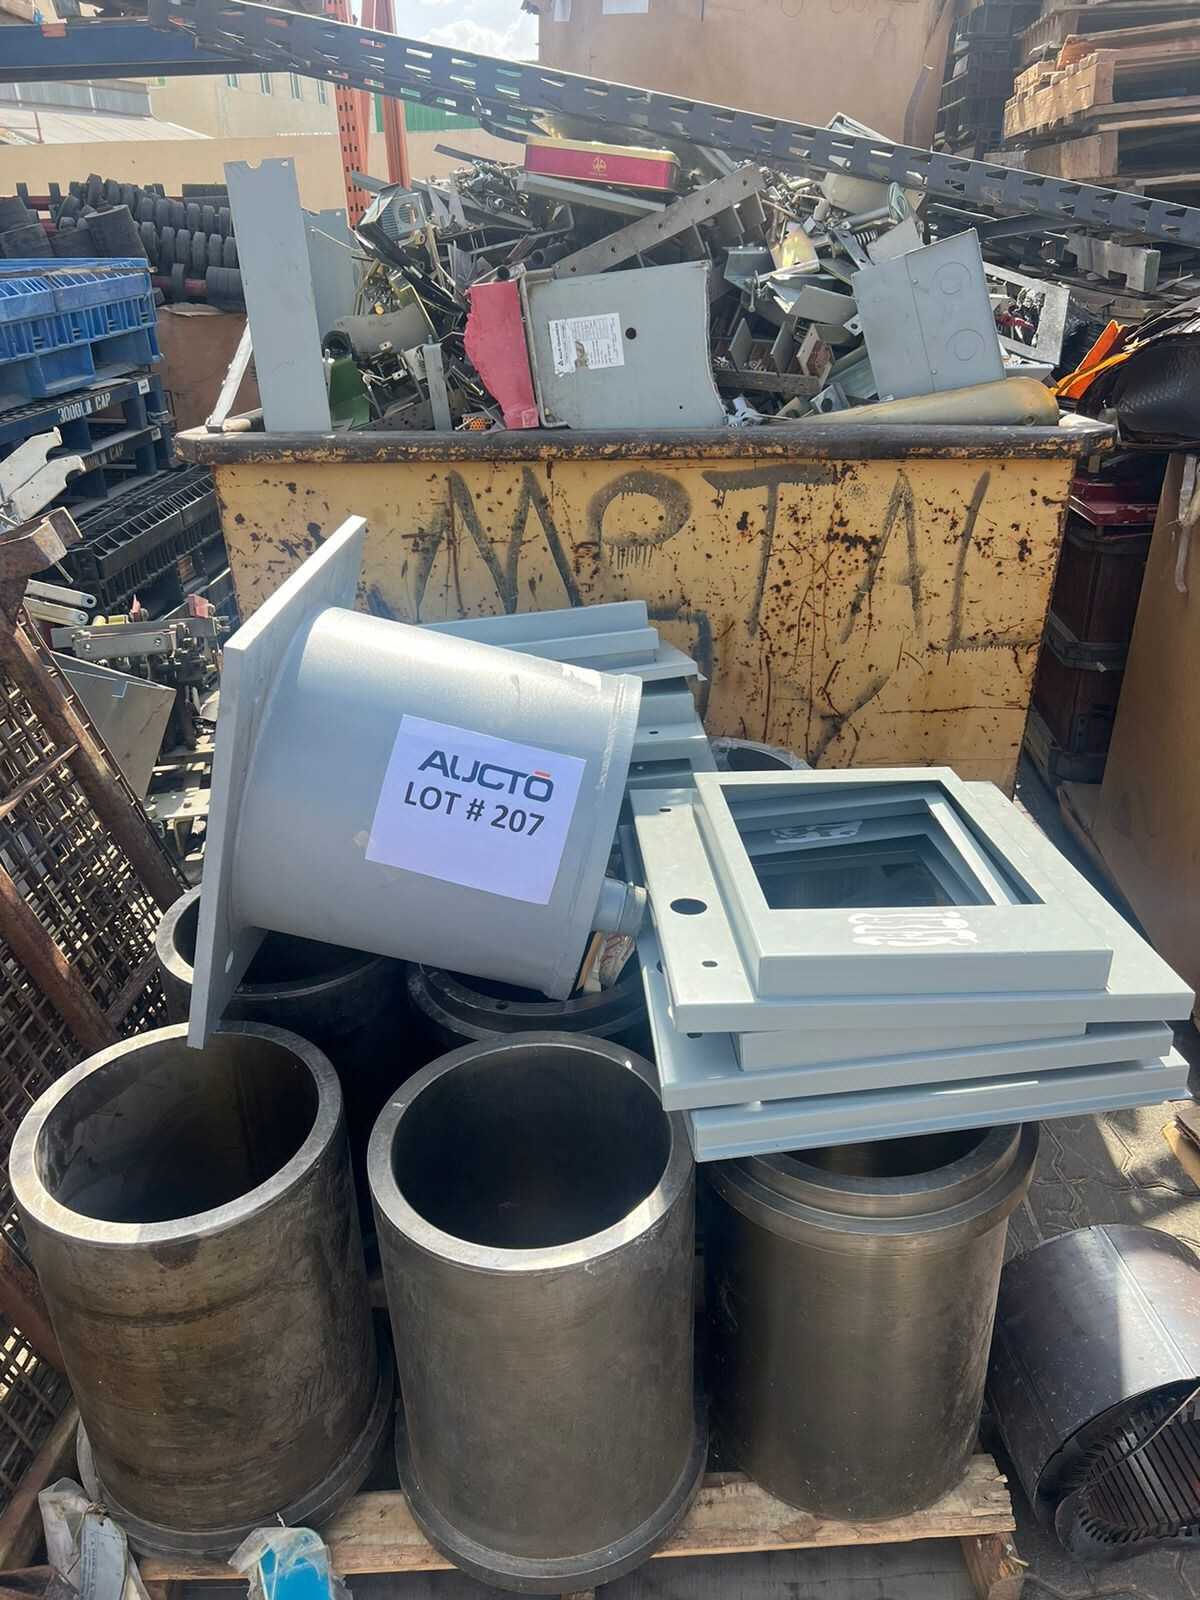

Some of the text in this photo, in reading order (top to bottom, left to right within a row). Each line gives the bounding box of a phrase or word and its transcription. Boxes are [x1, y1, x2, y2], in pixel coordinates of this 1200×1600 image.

[95, 392, 111, 410] CAP
[404, 781, 545, 836] LOT # 207
